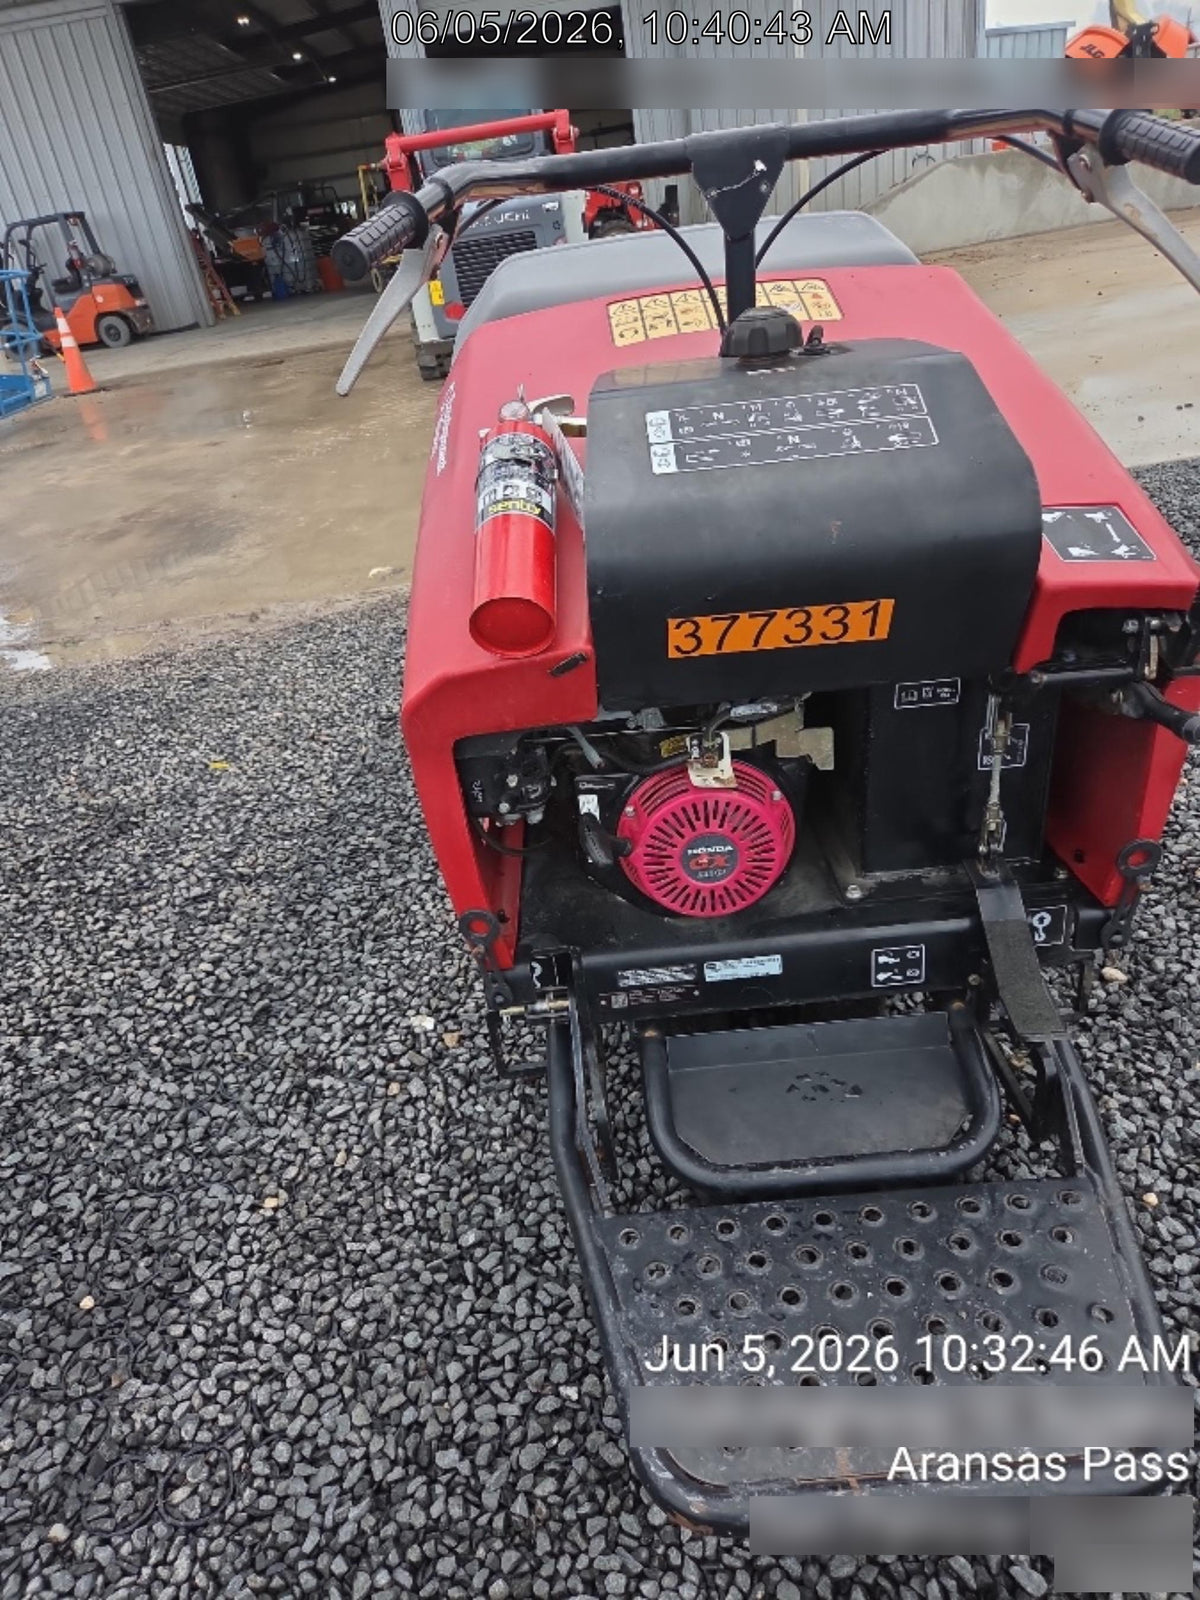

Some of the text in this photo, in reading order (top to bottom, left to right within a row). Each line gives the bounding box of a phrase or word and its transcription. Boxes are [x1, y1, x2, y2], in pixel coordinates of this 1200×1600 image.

[1080, 43, 1106, 59] JLG
[673, 599, 882, 655] 377331
[687, 844, 734, 856] HONDA
